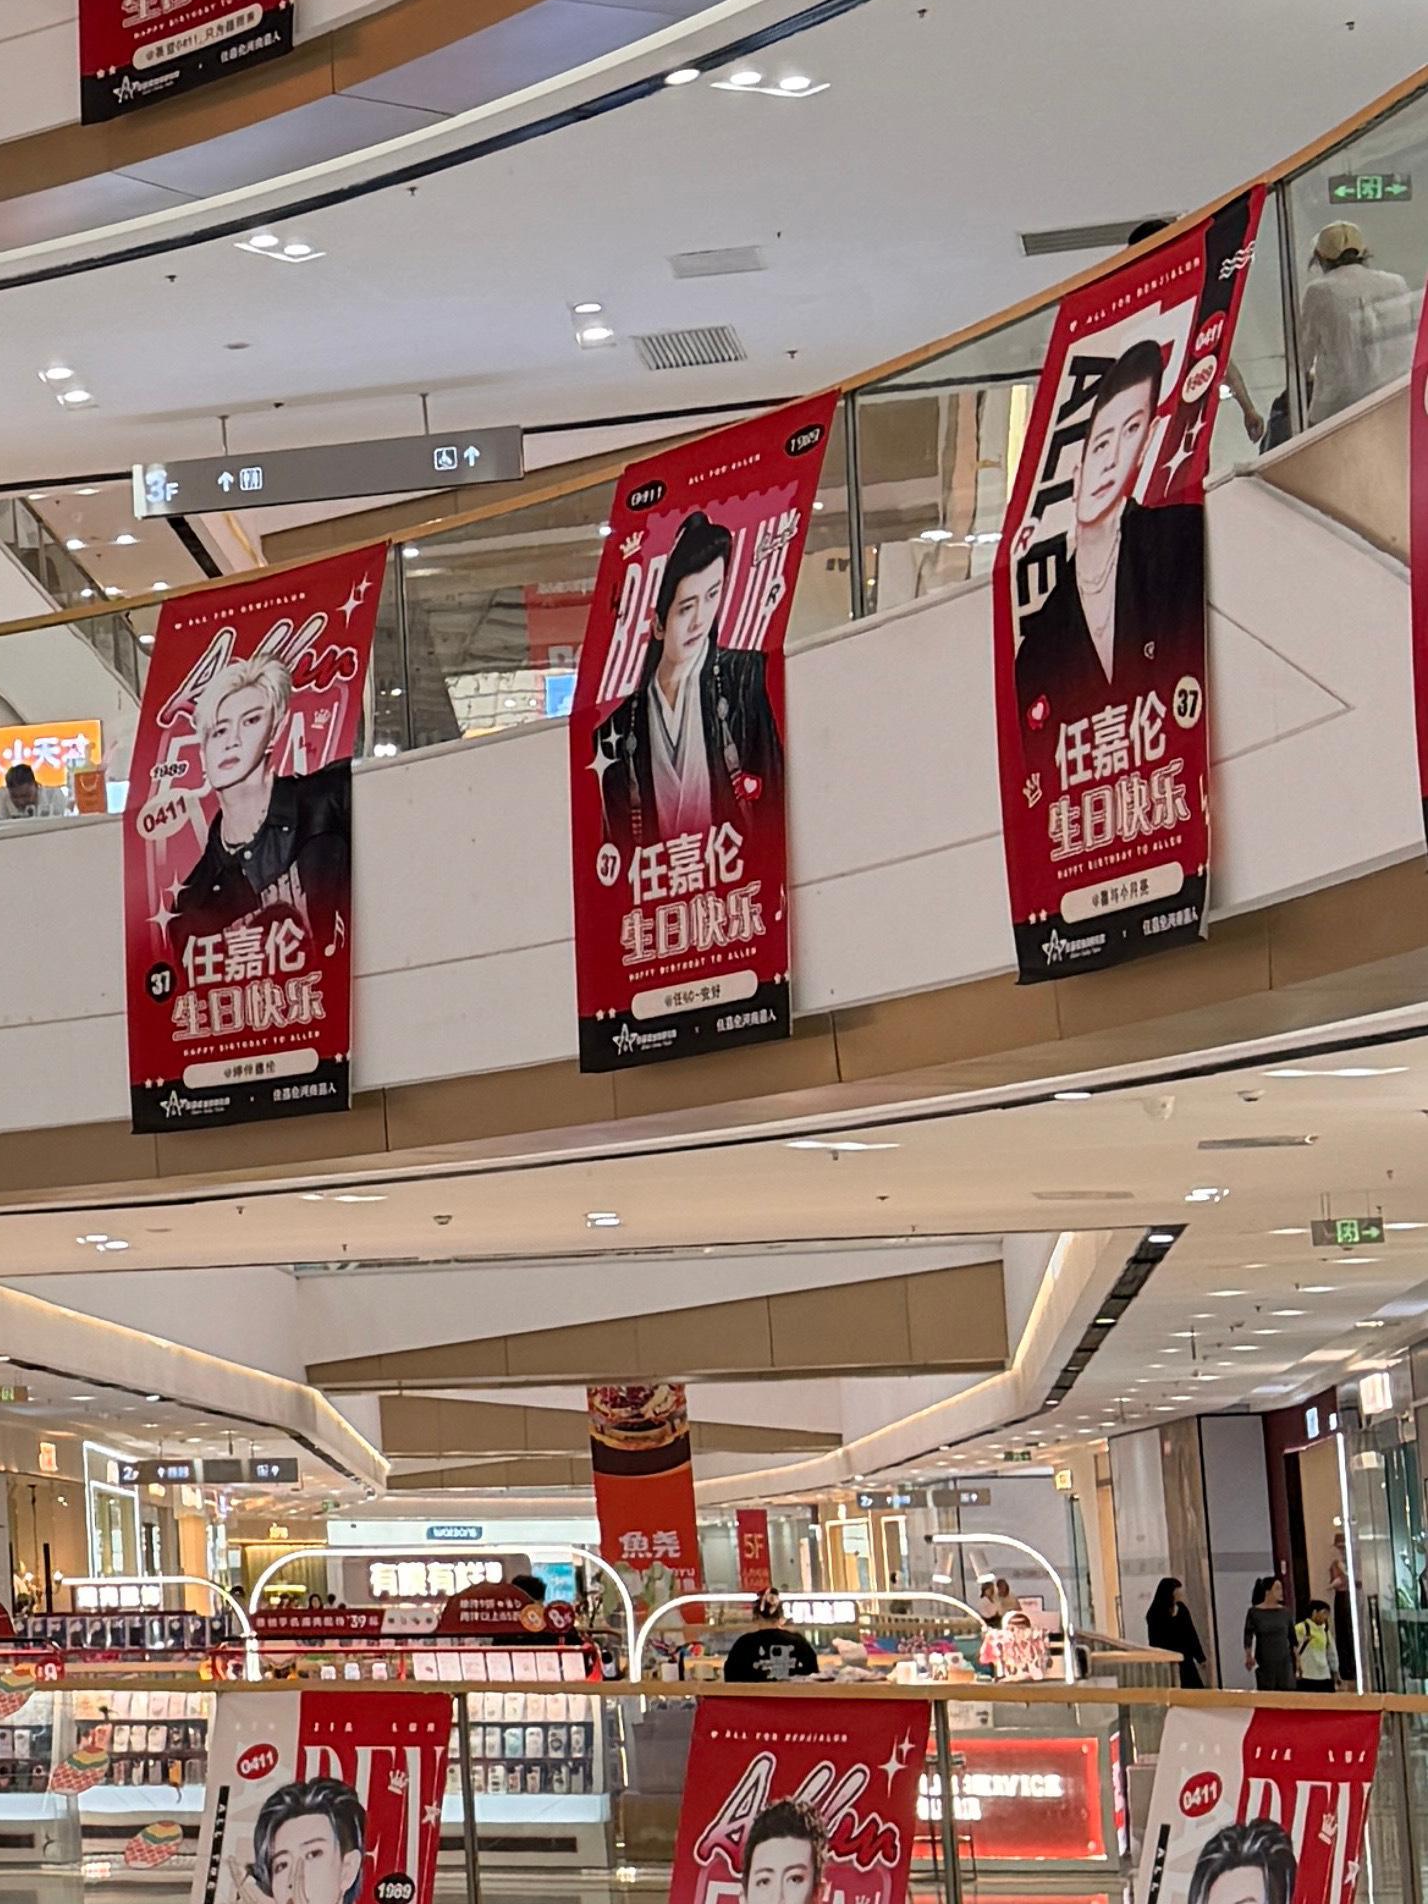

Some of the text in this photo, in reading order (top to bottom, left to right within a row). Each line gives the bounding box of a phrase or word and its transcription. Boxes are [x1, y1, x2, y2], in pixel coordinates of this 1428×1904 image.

[145, 468, 178, 503] 3F
[1177, 687, 1199, 719] 37
[1055, 694, 1166, 789] 任嘉伦
[1048, 758, 1191, 862] 生日快乐
[627, 823, 744, 904] 任嘉伦
[182, 919, 304, 988] 任嘉伦
[620, 881, 765, 966] 生日快乐
[171, 971, 325, 1040] 生日快乐
[1183, 1780, 1221, 1810] 0411
